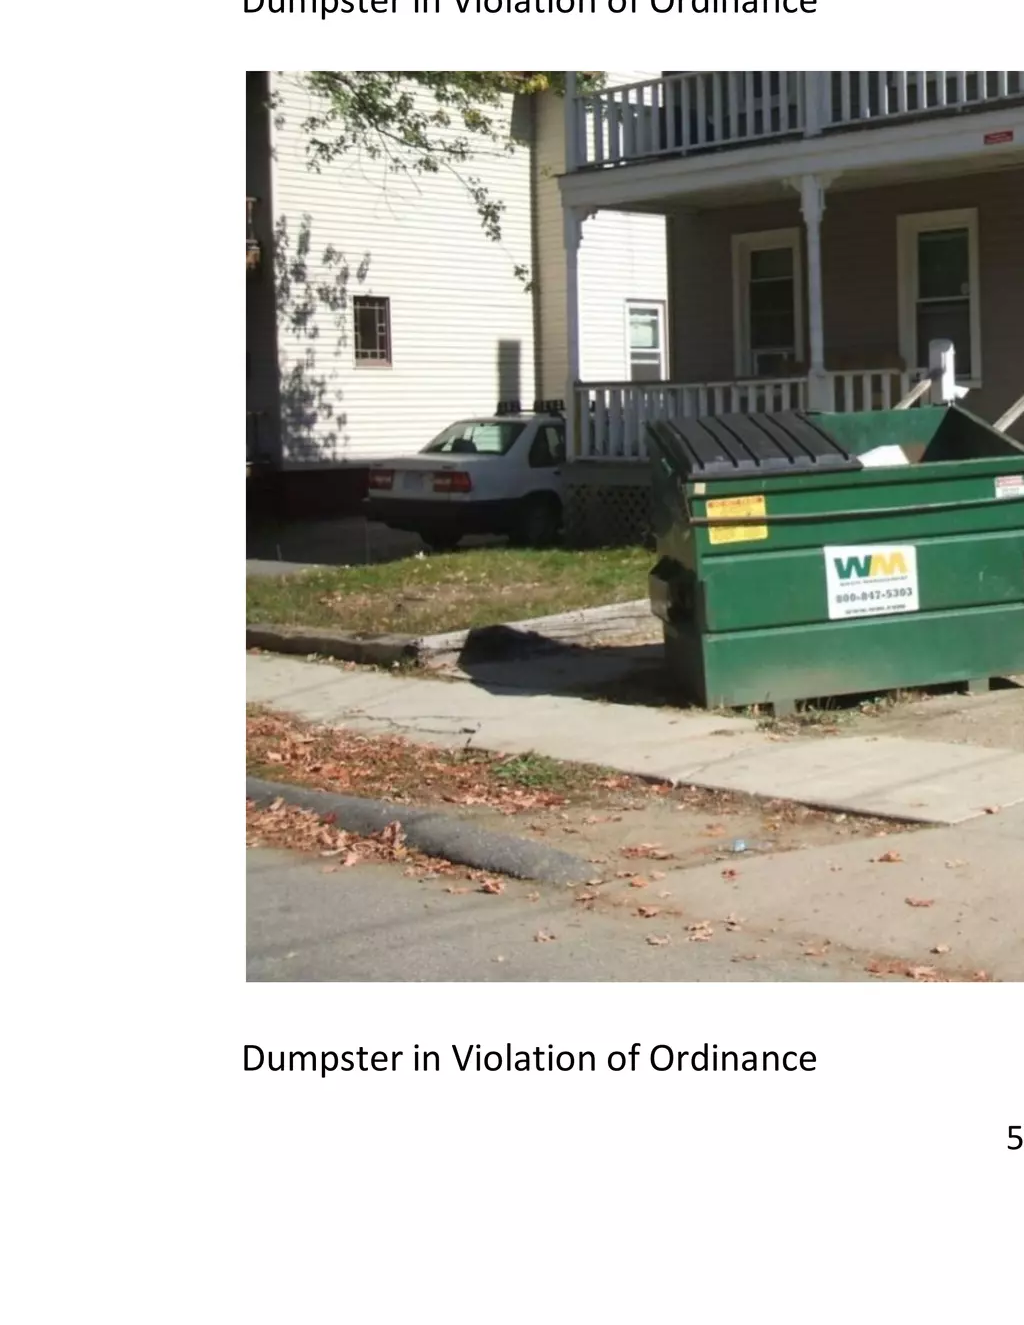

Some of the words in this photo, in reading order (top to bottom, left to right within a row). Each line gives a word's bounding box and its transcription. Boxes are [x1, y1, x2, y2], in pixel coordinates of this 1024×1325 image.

[833, 552, 908, 580] WM
[243, 1045, 404, 1078] Dumpster
[413, 1043, 440, 1071] in
[451, 1042, 596, 1071] Violation
[607, 1042, 642, 1071] of
[650, 1042, 818, 1071] Ordinance
